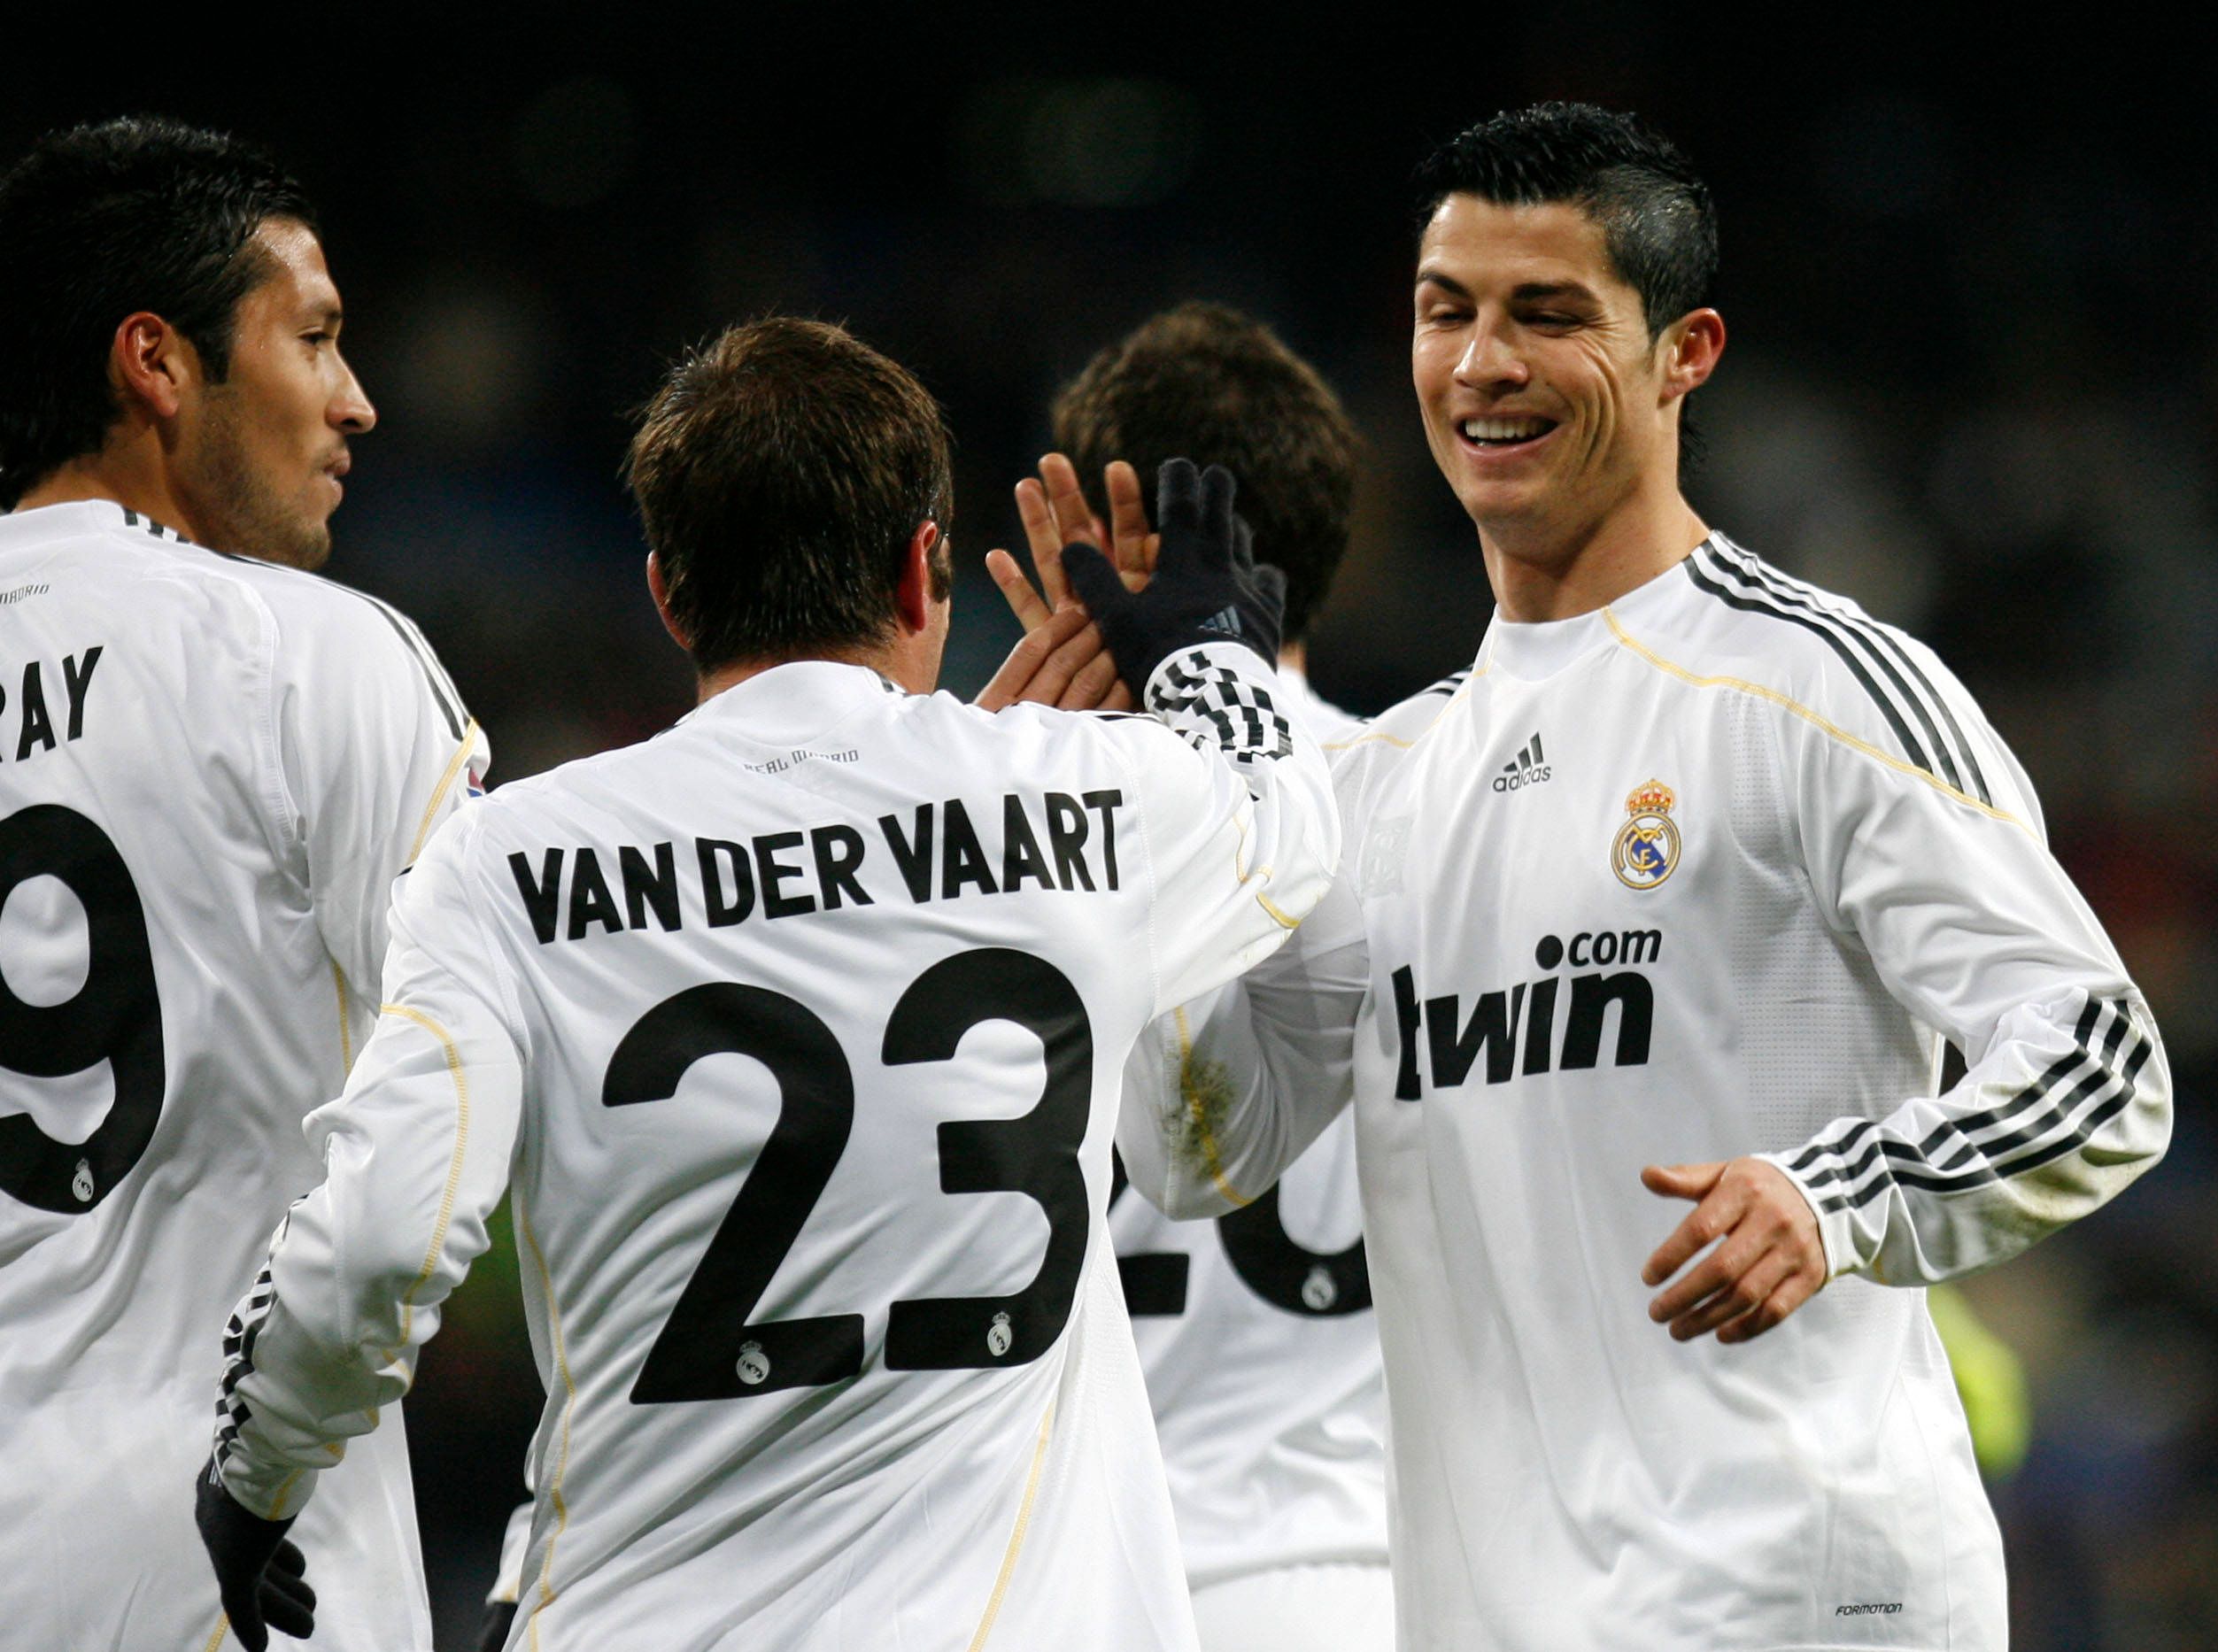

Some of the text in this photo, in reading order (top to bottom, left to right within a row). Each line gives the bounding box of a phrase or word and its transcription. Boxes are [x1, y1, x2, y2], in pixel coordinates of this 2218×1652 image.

[0, 645, 104, 762] AY
[792, 749, 859, 763] MRID
[1492, 765, 1551, 792] adidas
[507, 789, 1123, 945] VAN DER VAART
[0, 803, 166, 1215] 9
[602, 947, 1094, 1404] 23
